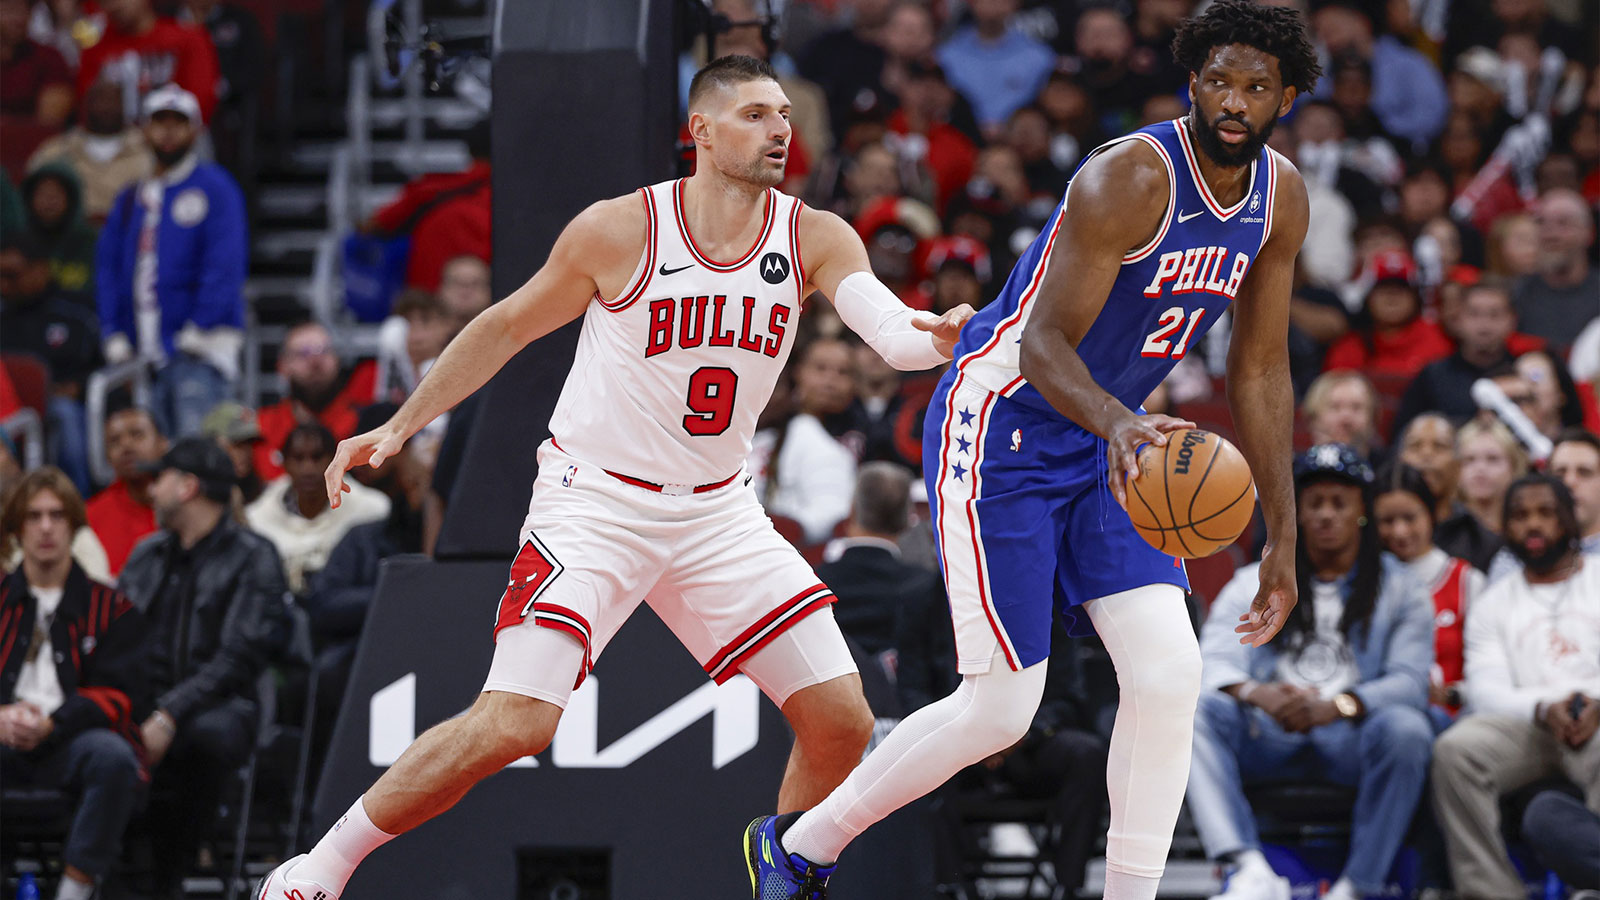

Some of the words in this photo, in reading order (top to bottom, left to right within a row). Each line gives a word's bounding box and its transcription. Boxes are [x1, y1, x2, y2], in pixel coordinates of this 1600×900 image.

[1239, 216, 1264, 224] crypto.com
[1143, 246, 1250, 300] PHILA
[645, 295, 791, 359] BULLS
[1141, 306, 1206, 360] 21
[682, 366, 739, 437] 9
[1174, 430, 1209, 475] ilson
